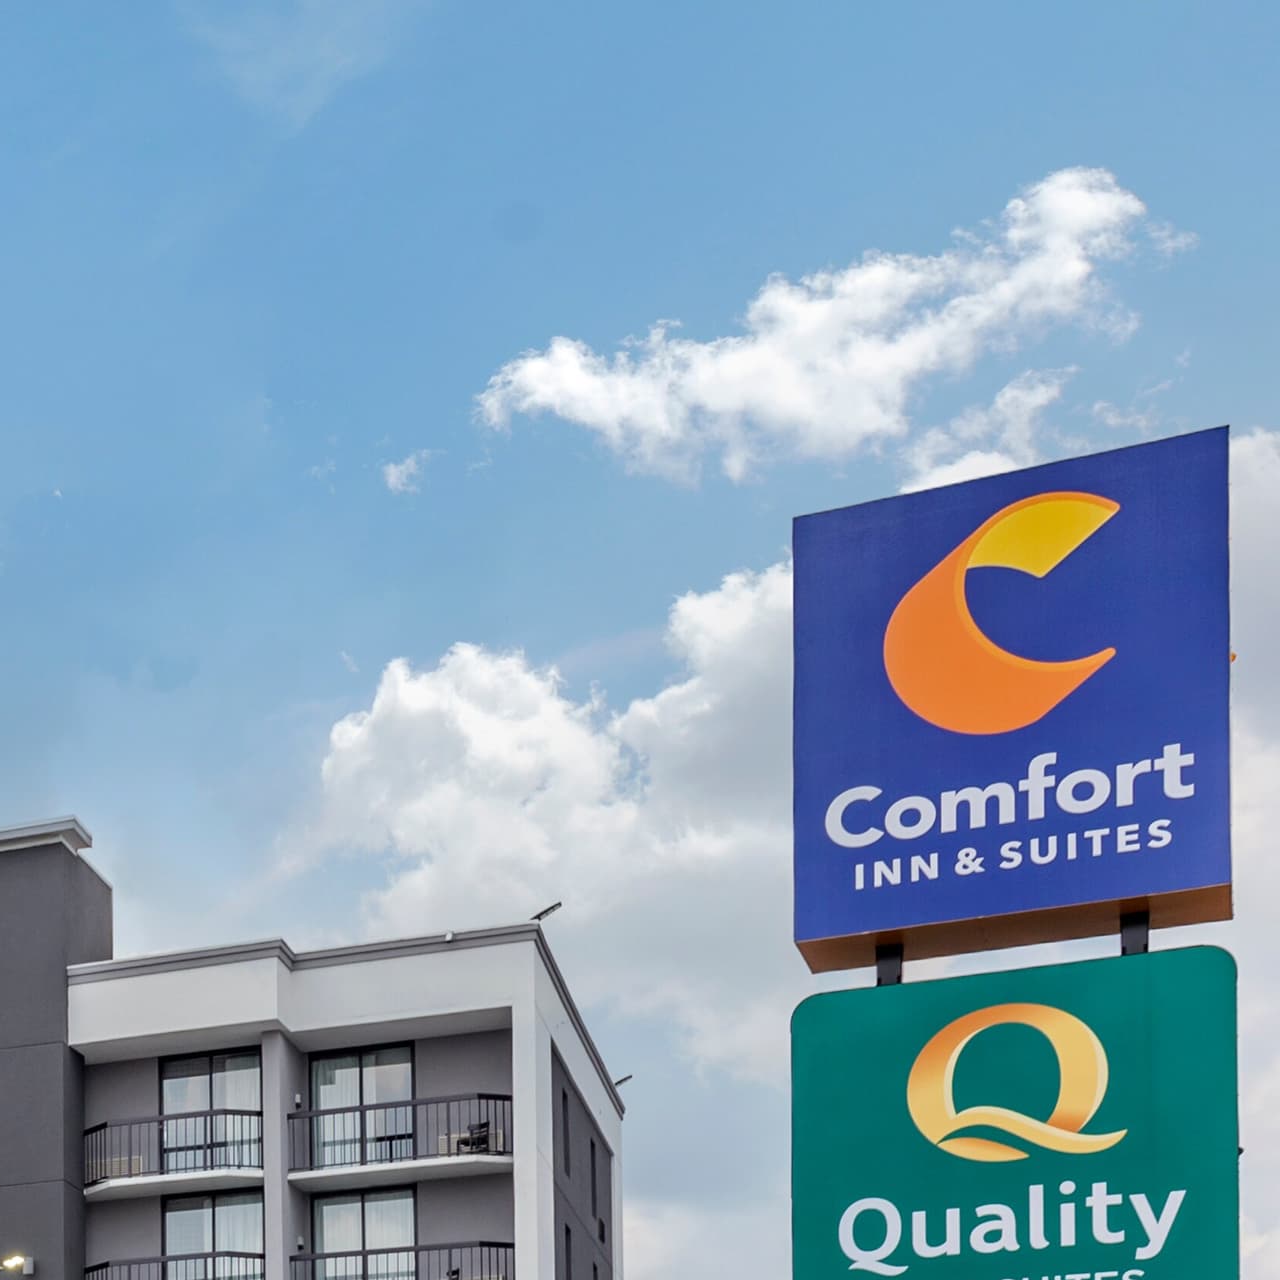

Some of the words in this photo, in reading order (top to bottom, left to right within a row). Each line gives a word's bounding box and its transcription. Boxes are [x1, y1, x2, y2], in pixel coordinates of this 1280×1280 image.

[824, 743, 1195, 849] Comfort
[855, 852, 939, 890] INN
[953, 847, 985, 876] &
[1000, 818, 1173, 870] SUITES
[838, 1180, 1187, 1277] Quality
